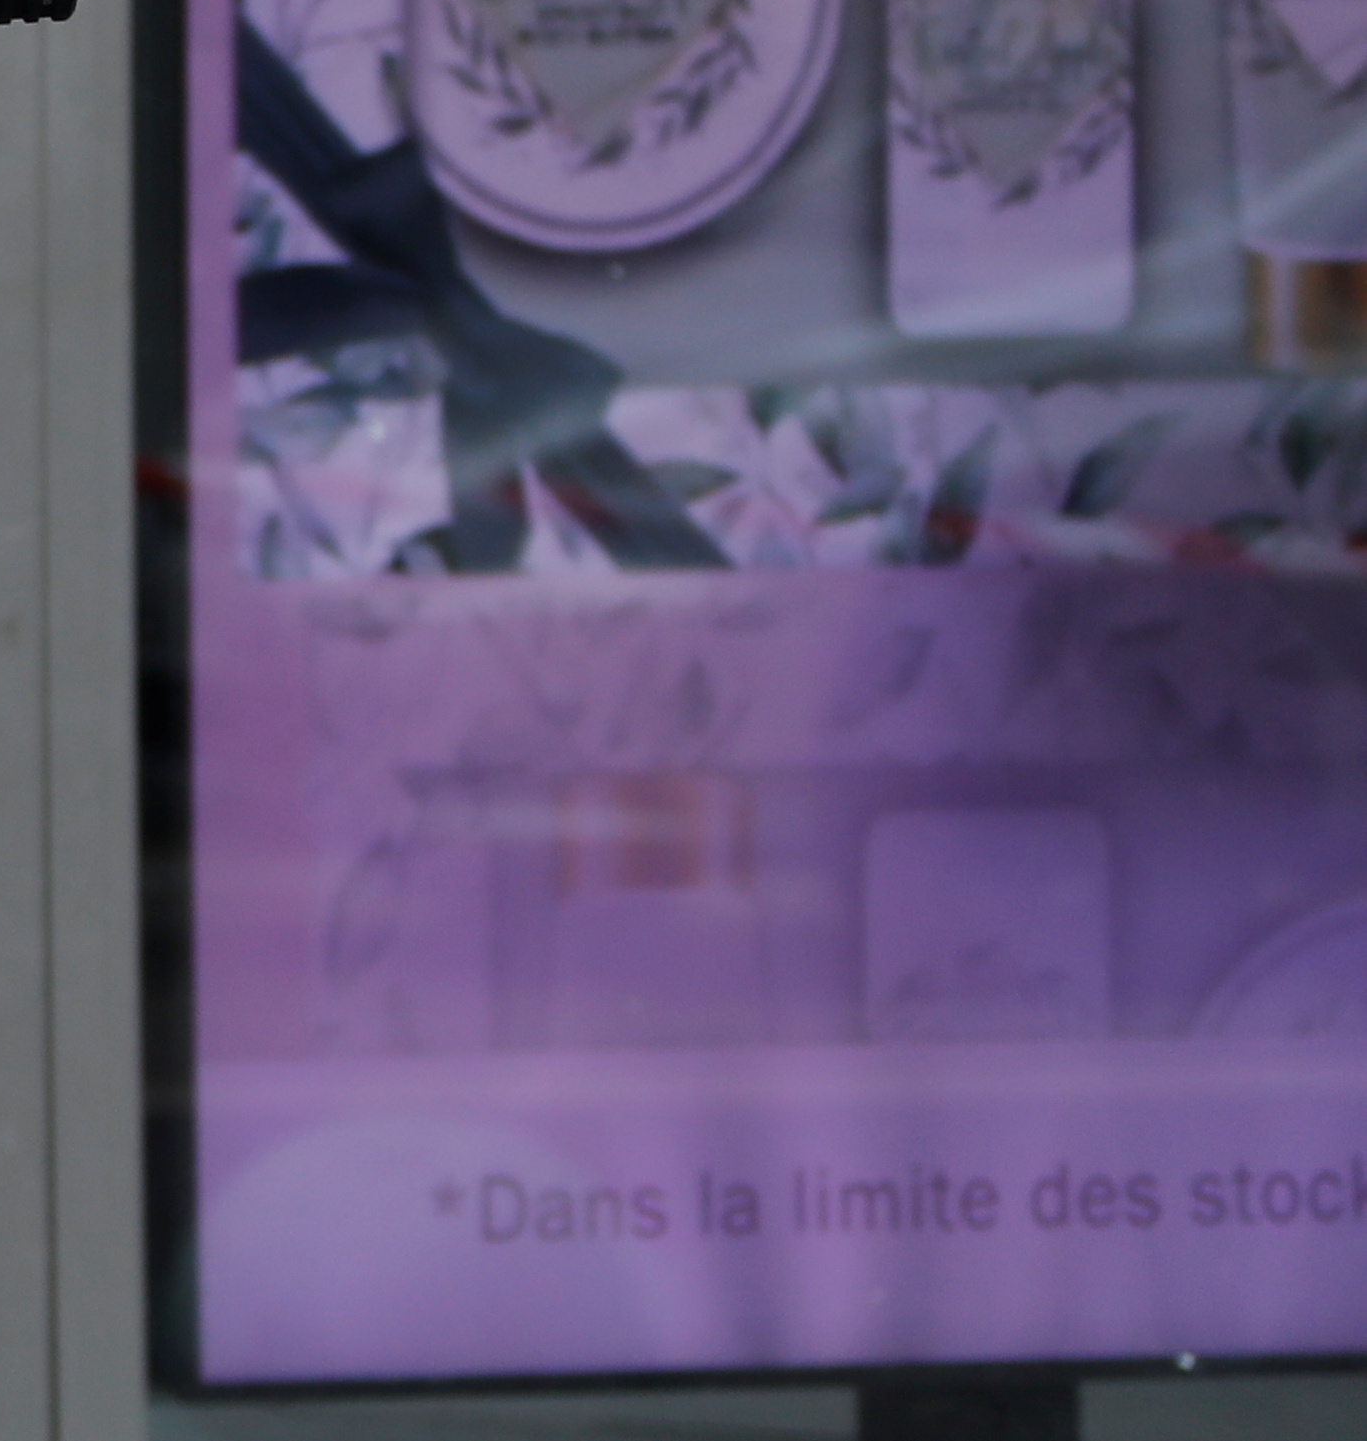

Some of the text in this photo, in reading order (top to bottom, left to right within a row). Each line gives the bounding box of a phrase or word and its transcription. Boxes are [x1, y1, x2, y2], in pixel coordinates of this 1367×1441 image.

[699, 1169, 761, 1237] la
[795, 1163, 1000, 1234] limite
[1030, 1162, 1162, 1230] des
